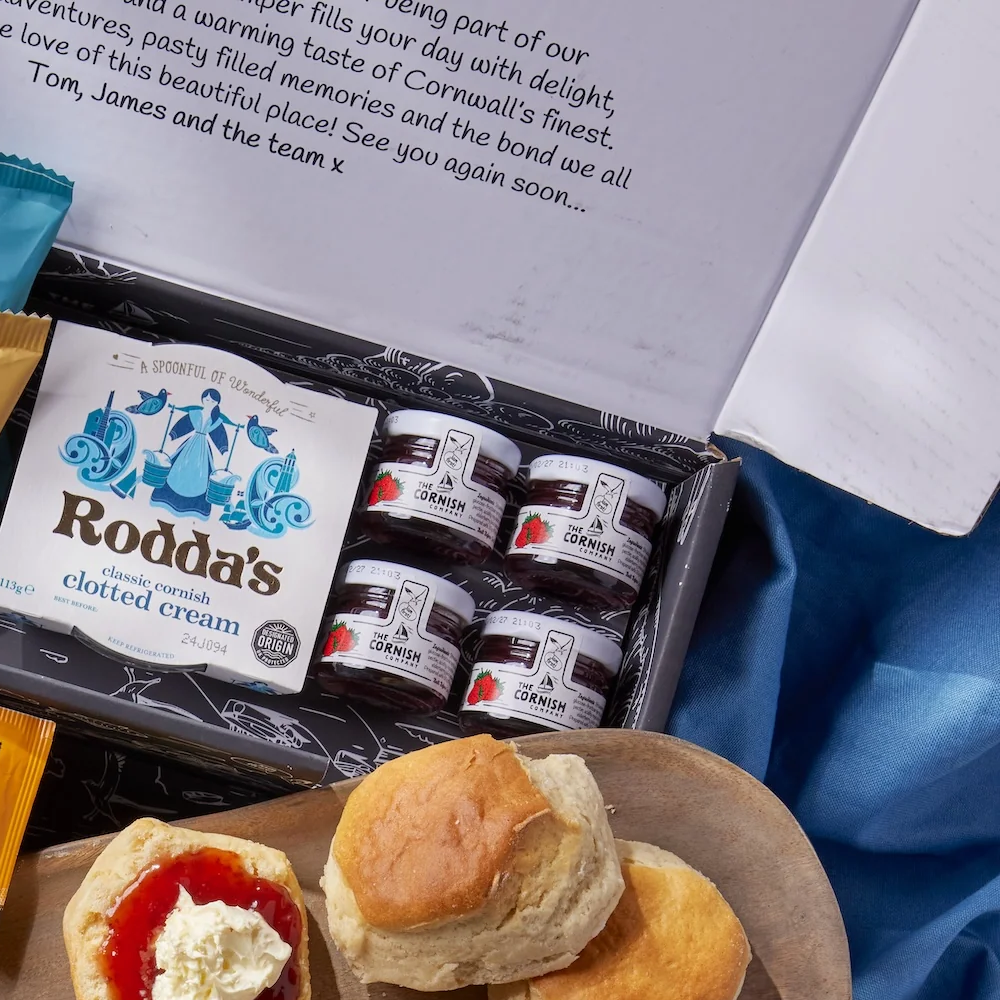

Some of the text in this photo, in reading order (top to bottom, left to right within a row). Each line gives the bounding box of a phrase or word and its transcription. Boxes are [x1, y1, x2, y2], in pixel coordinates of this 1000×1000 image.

[453, 14, 509, 42] part
[514, 30, 545, 52] of
[545, 42, 589, 65] our
[310, 1, 353, 33] fills
[356, 23, 417, 51] your
[421, 36, 464, 72] day
[470, 55, 523, 85] with
[529, 68, 616, 119] delight,
[172, 4, 187, 21] a
[194, 9, 295, 57] warming
[303, 36, 365, 73] taste
[371, 62, 402, 83] of
[404, 69, 536, 124] Cornwall's
[541, 108, 614, 150] finest.
[20, 22, 69, 56] love
[76, 44, 105, 65] of
[108, 49, 152, 81] this
[158, 64, 262, 114] beautiful
[265, 100, 338, 137] place!
[342, 121, 391, 151] See
[392, 141, 439, 164] you
[444, 156, 506, 187] again
[511, 176, 587, 213] soon...
[28, 60, 345, 174] Tom, James and the team x
[141, 30, 208, 68] pasty
[216, 46, 277, 82] filled
[280, 71, 396, 118] memories
[400, 109, 448, 134] and
[452, 117, 491, 146] the
[497, 130, 559, 167] bond
[560, 156, 596, 178] we
[600, 166, 632, 190] all
[140, 359, 290, 417] A SPOONFUL OF Wonderful
[418, 481, 433, 490] THE
[414, 489, 466, 513] CORNISH
[429, 505, 464, 518] COMPANY
[568, 524, 584, 534] THE
[52, 490, 285, 597] Rodda's
[564, 532, 616, 557] CORNISH
[579, 547, 613, 562] COMPANY
[102, 565, 211, 606] classic cornish
[53, 595, 72, 606] BEST
[62, 570, 241, 636] clotted cream
[107, 635, 176, 661] KEEP REFRIGERATED
[257, 635, 295, 656] ORIGIN
[261, 628, 295, 644] DESIGNATED
[374, 632, 389, 641] THE
[369, 640, 422, 663] CORNISH
[385, 655, 419, 668] COMPANY
[518, 682, 533, 691] THE
[514, 690, 566, 714] CORNISH
[530, 705, 564, 718] COMPANY
